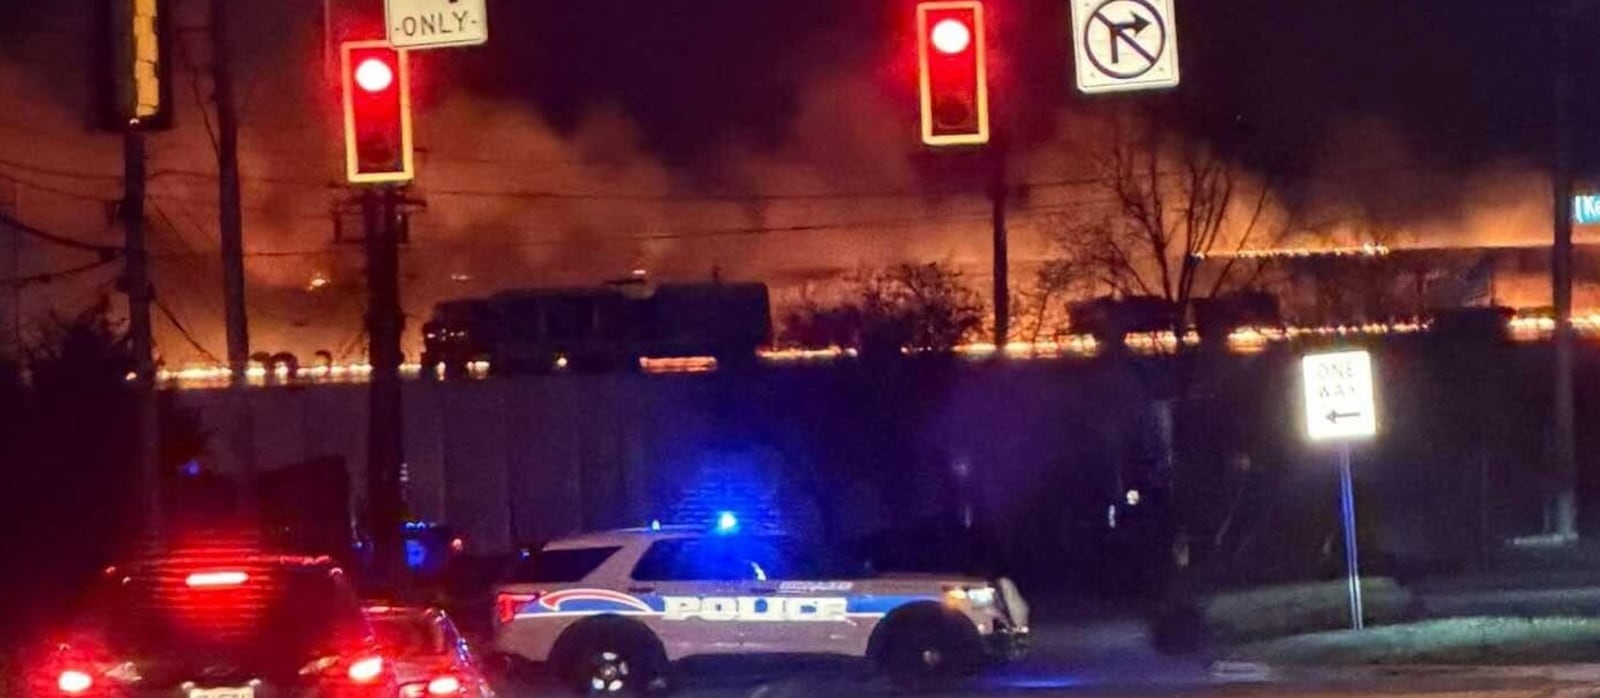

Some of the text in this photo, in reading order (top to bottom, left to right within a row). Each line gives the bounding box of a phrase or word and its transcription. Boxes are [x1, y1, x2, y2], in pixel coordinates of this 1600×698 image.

[402, 10, 468, 37] ONLY
[1318, 360, 1355, 379] ONE
[1318, 383, 1357, 398] WAY
[661, 596, 848, 621] POLICE
